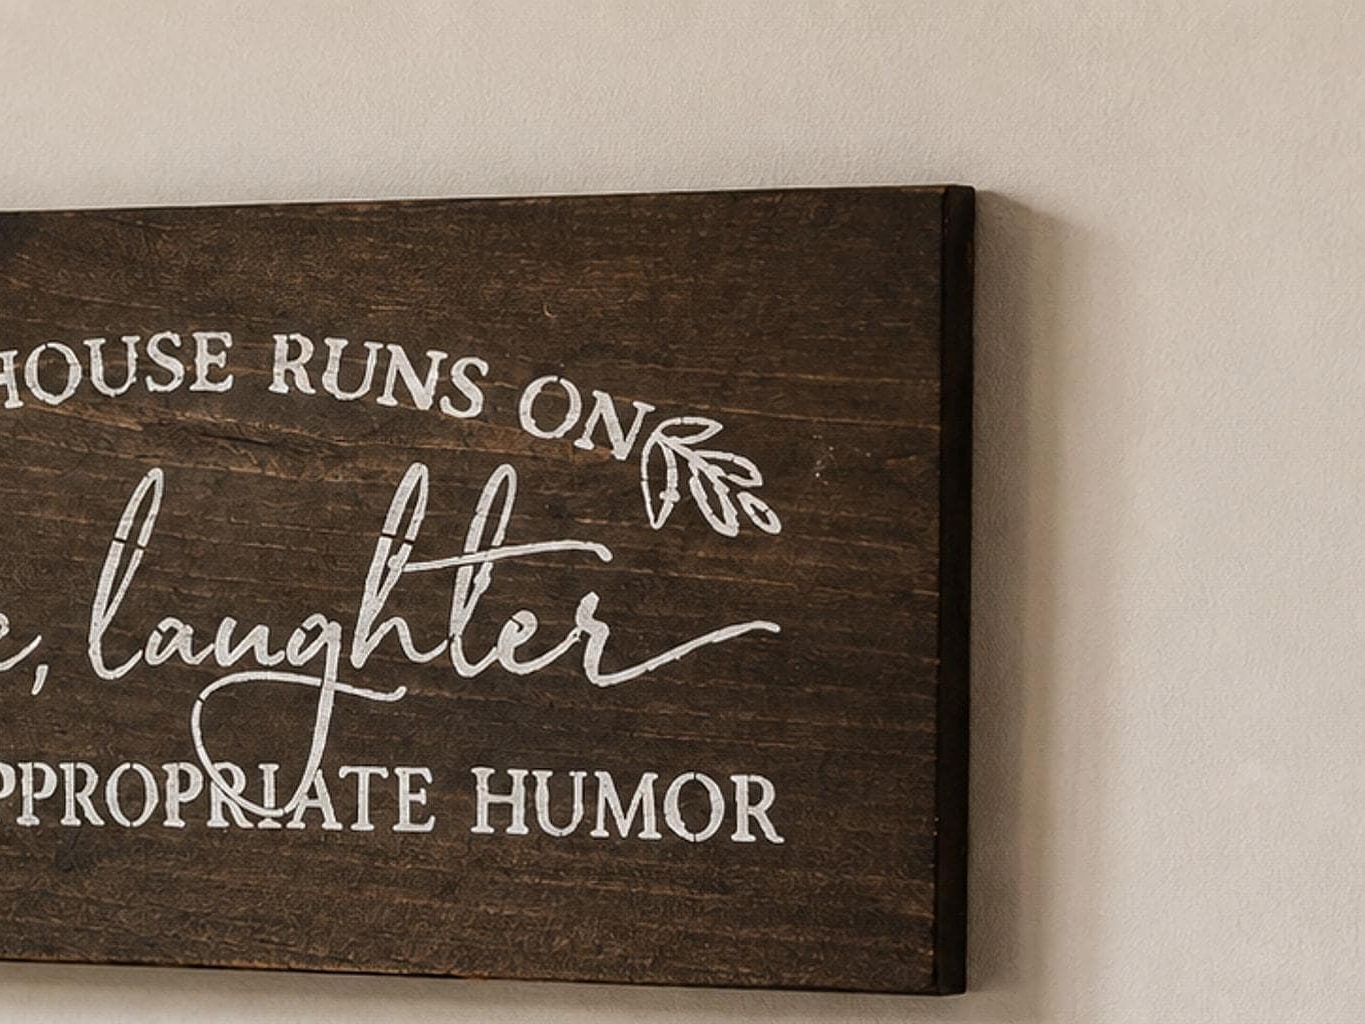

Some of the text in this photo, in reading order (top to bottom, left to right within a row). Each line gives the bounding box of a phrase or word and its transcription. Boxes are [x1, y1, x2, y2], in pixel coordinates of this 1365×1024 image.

[268, 332, 489, 419] RUNS
[518, 375, 656, 461] ON
[87, 462, 781, 817] laughter
[470, 766, 785, 844] HUMOR
